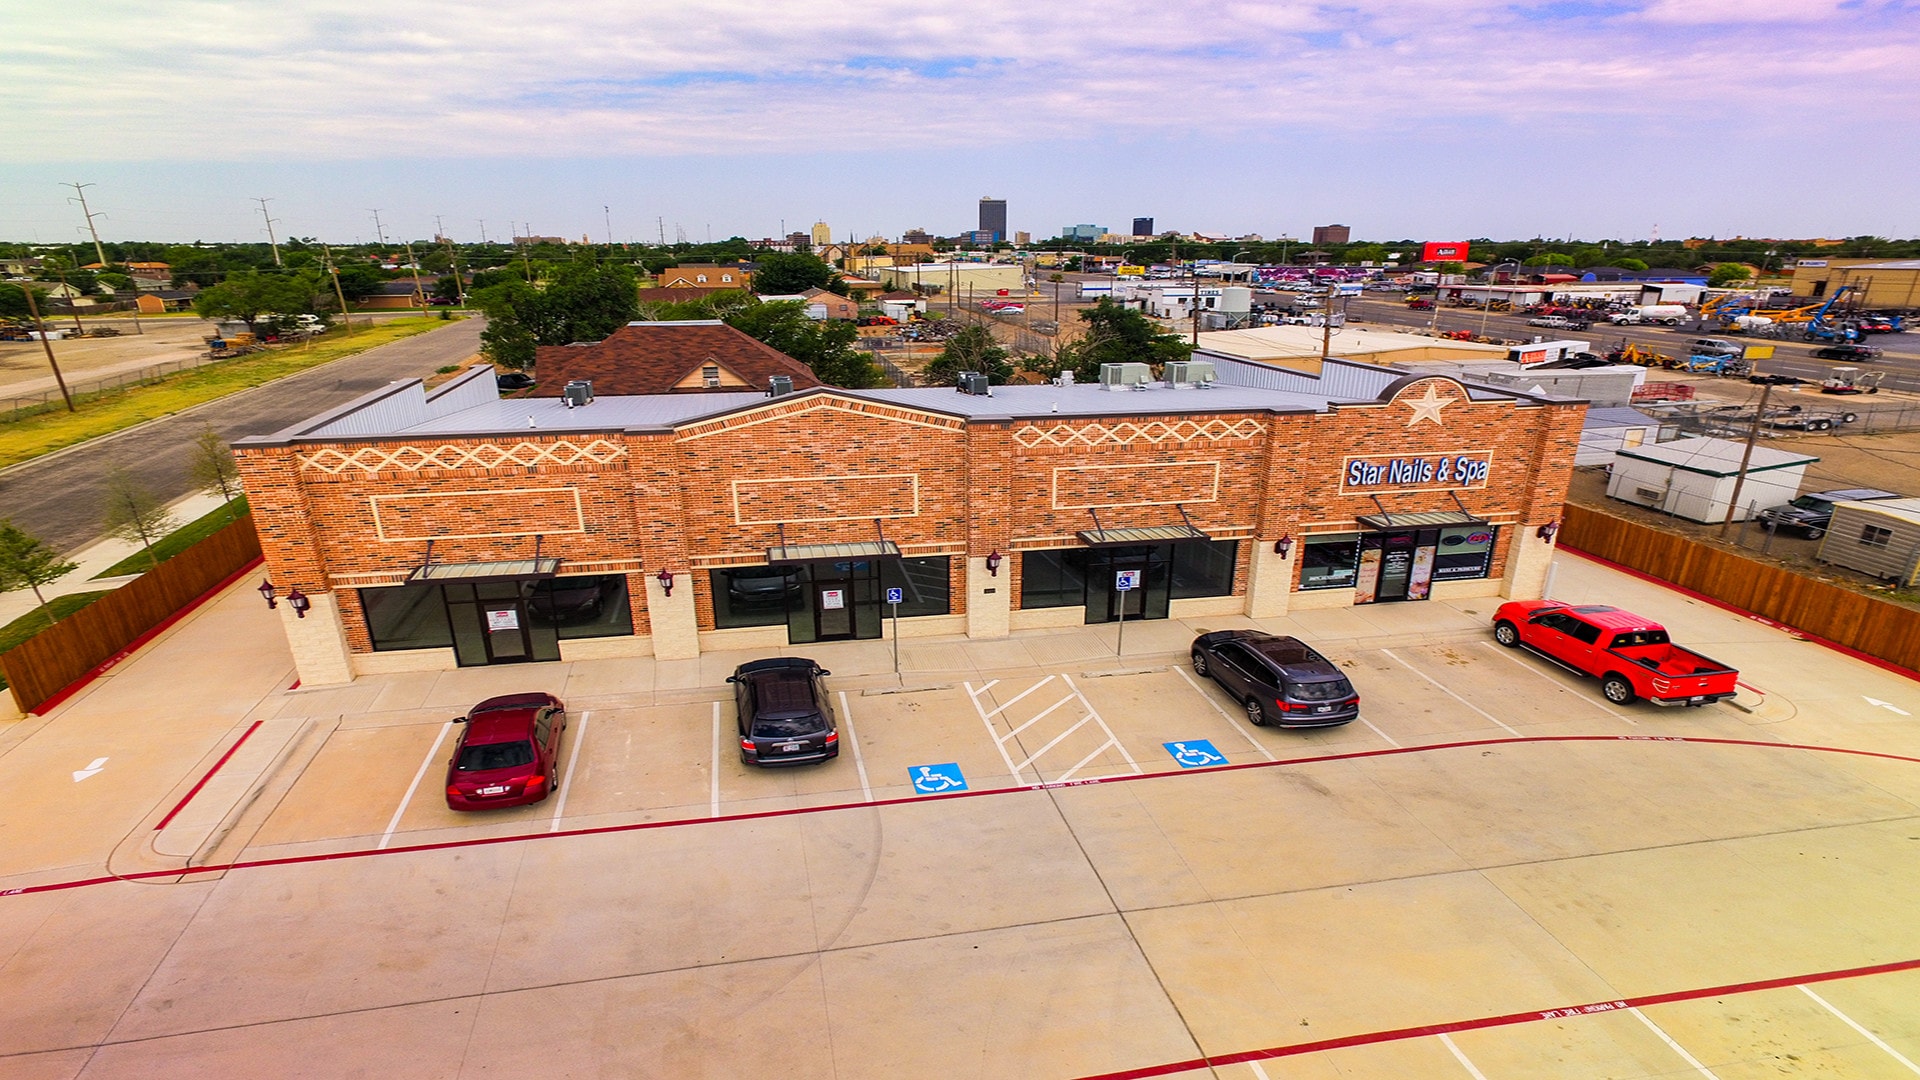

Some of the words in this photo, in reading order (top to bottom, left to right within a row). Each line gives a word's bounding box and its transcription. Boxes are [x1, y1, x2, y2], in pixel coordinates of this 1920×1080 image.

[1348, 459, 1386, 486] Star
[1388, 458, 1433, 484] Nails
[1436, 457, 1450, 482] &
[1453, 455, 1488, 486] Spa
[1614, 1000, 1629, 1009] NO
